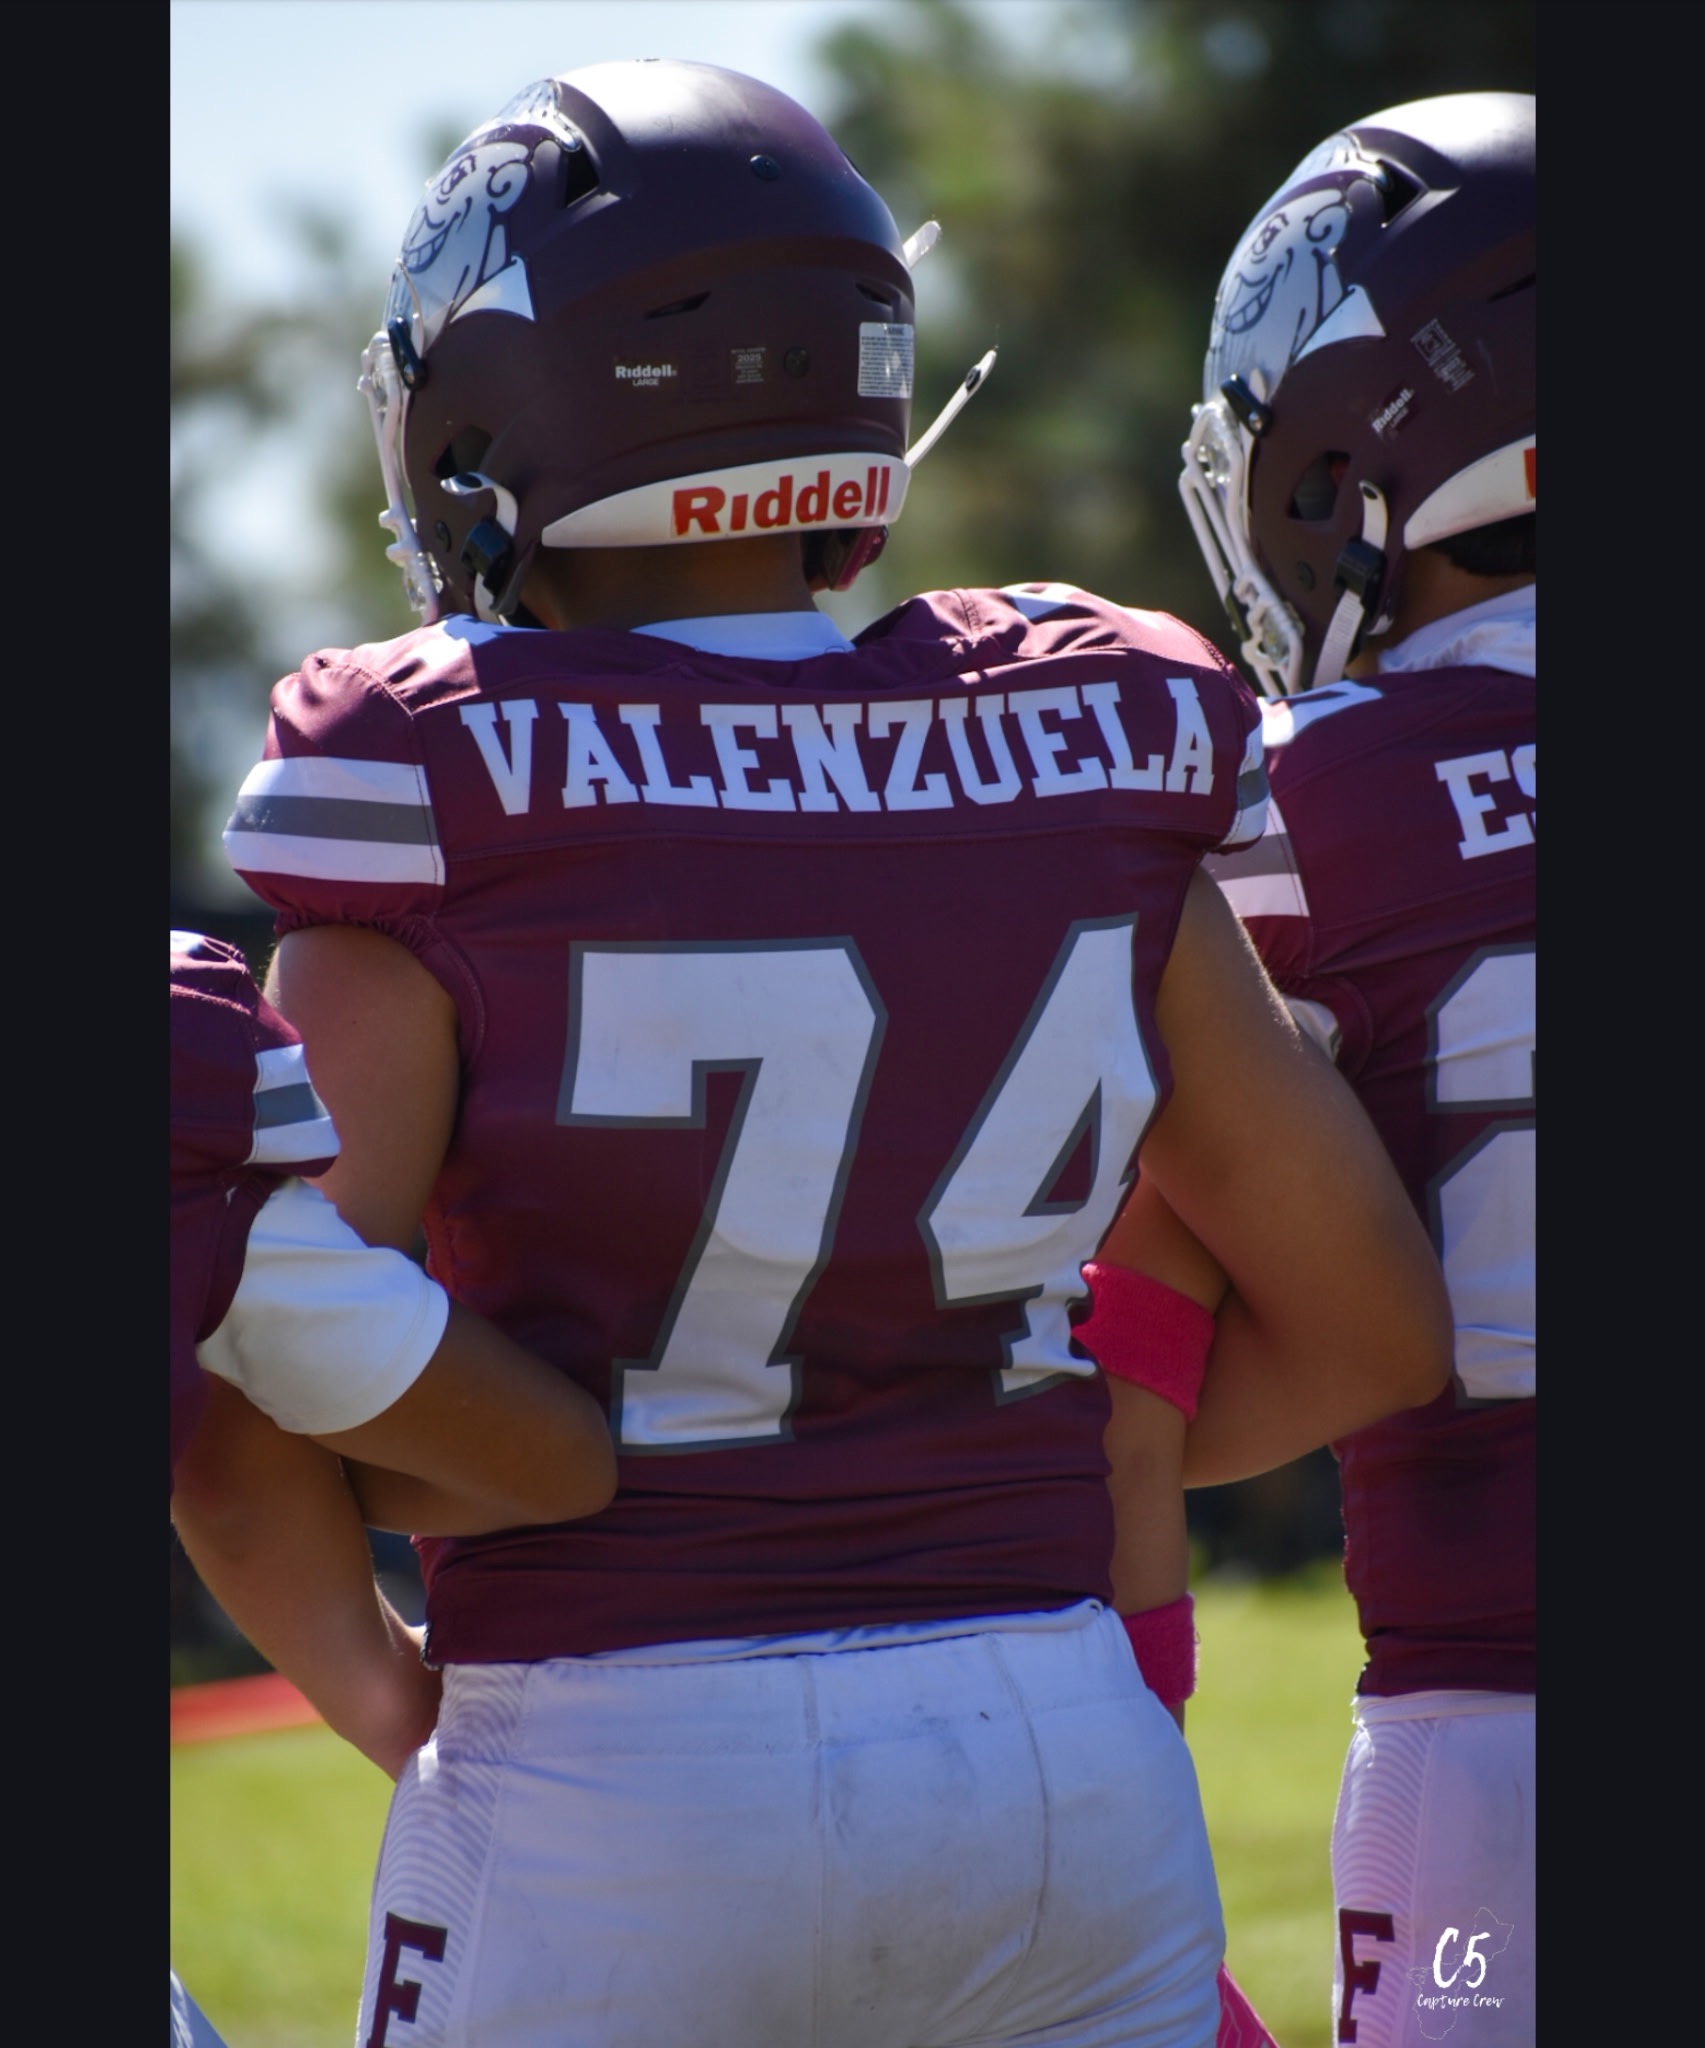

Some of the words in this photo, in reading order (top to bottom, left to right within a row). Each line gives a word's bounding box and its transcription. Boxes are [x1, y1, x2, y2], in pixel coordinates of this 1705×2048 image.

[615, 364, 672, 379] Riddell
[1372, 388, 1411, 432] Riddell
[672, 466, 891, 537] Riddell
[459, 677, 1215, 816] VALENZUELA
[556, 912, 1162, 1456] 74
[366, 1911, 448, 2048] F
[1338, 1907, 1396, 2043] F
